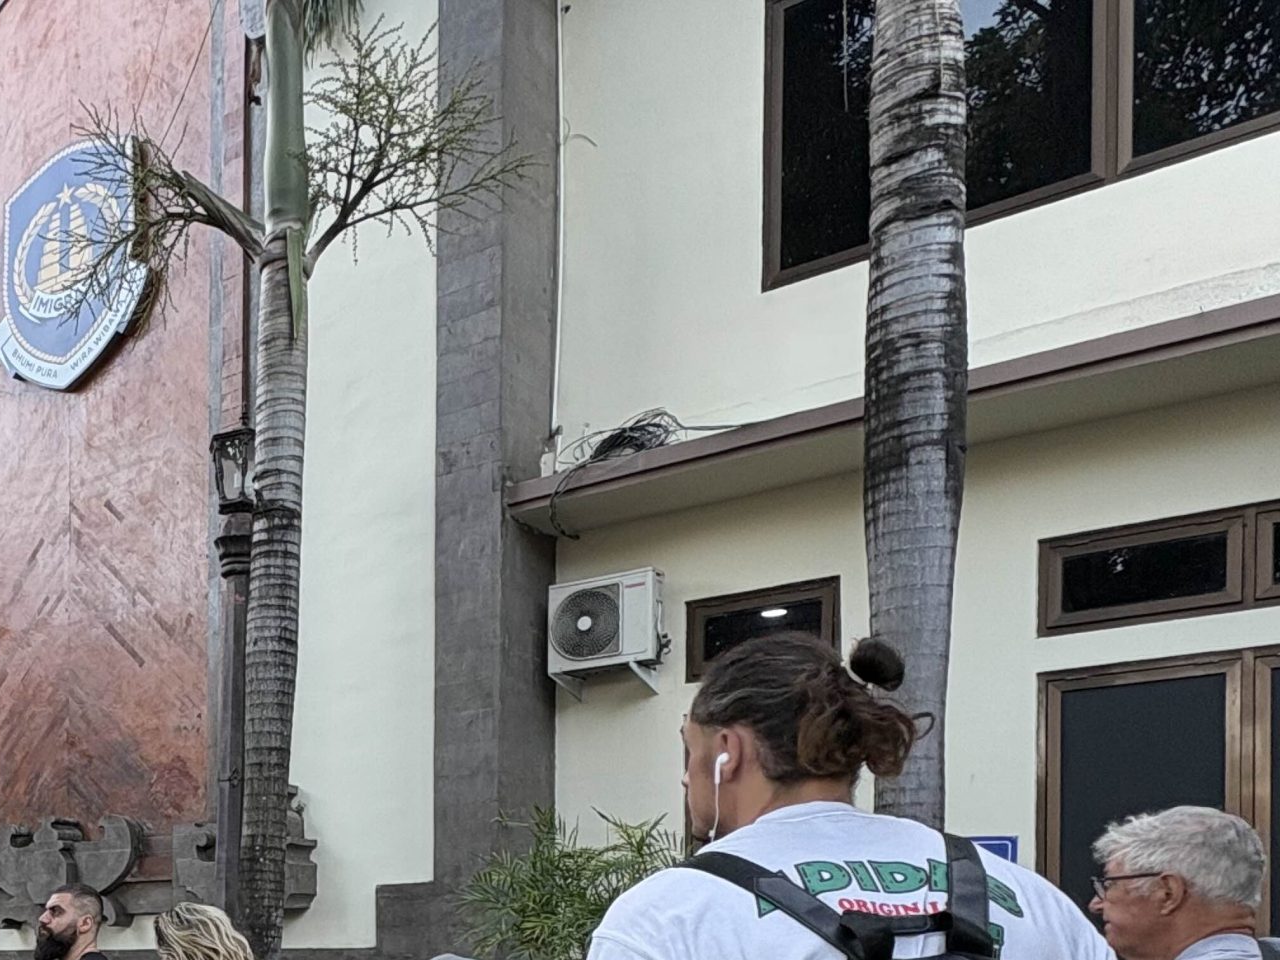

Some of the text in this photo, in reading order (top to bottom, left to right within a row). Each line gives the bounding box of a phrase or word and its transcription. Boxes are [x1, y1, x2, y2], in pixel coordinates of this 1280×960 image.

[11, 348, 35, 372] BHUMI
[35, 365, 58, 379] PURA
[70, 345, 93, 371] WIRA
